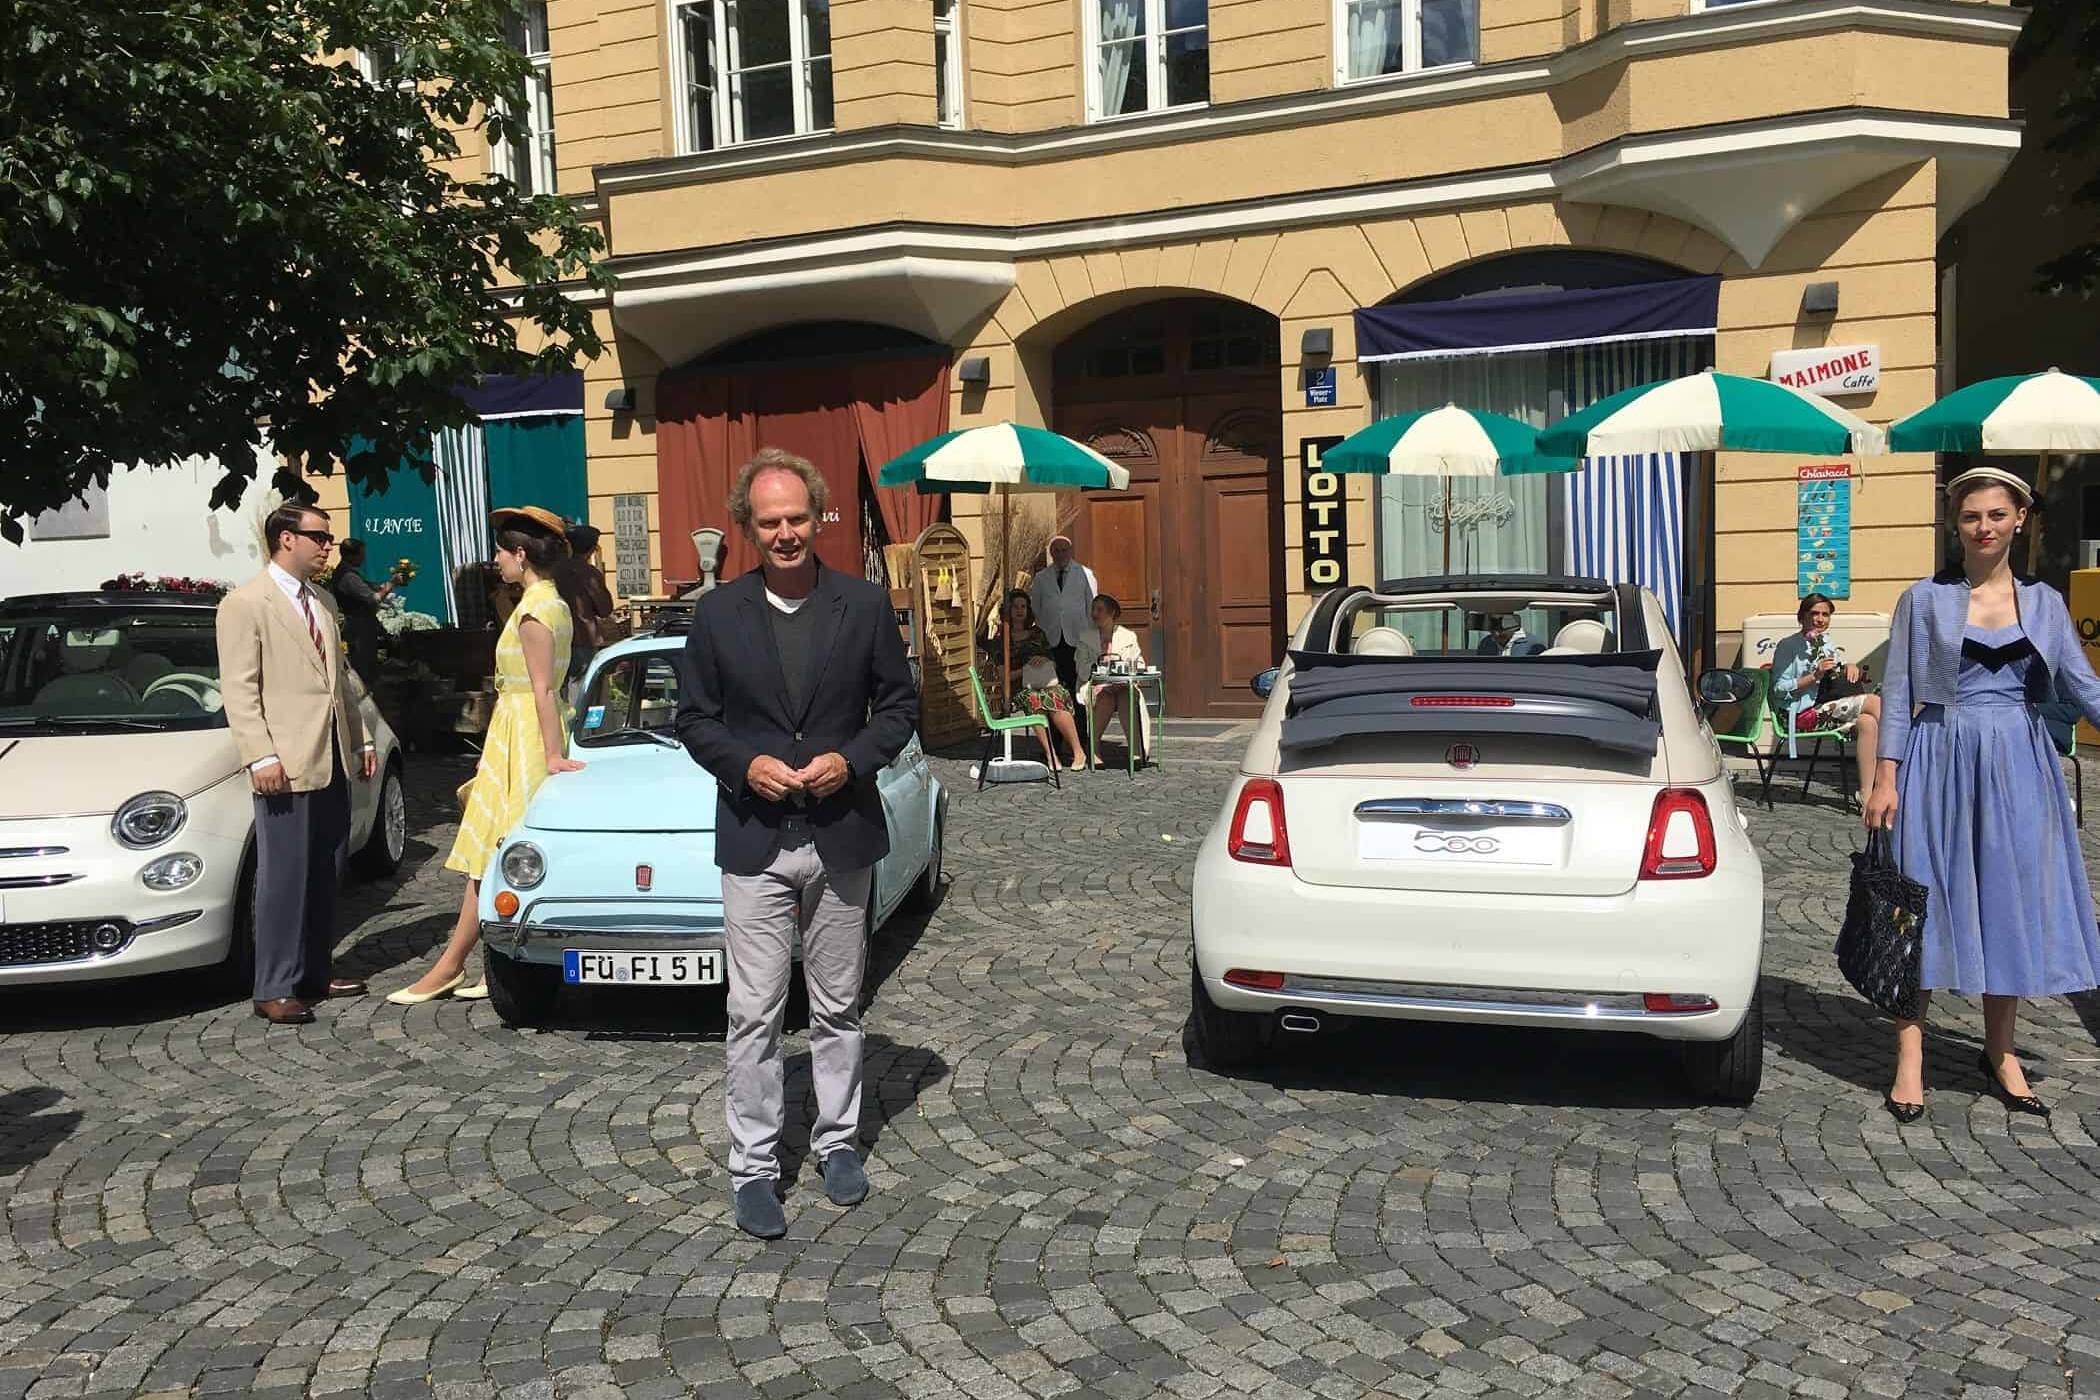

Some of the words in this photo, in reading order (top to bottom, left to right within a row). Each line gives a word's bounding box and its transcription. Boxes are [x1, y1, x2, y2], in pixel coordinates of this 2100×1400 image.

[1778, 350, 1872, 388] MAIMONE
[1307, 444, 1340, 584] LOTTO
[581, 955, 614, 980] FÜ
